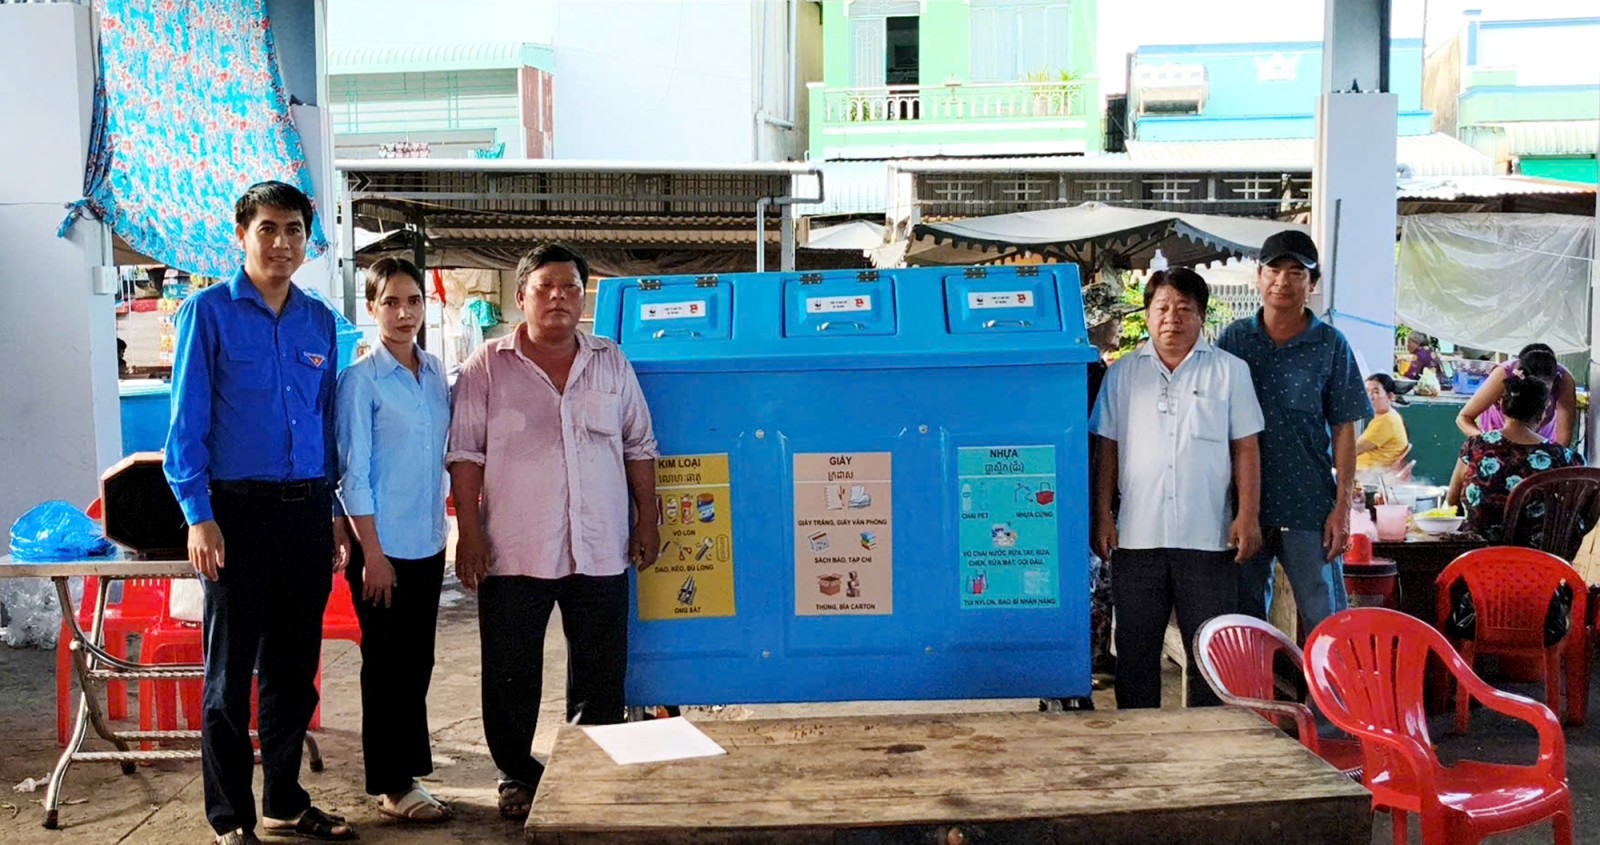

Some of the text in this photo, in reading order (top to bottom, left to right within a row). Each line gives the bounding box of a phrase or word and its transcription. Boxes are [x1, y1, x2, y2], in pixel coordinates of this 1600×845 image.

[990, 448, 1019, 459] NHỰA
[658, 458, 701, 469] KIM LOẠI
[829, 455, 852, 466] GIẤY
